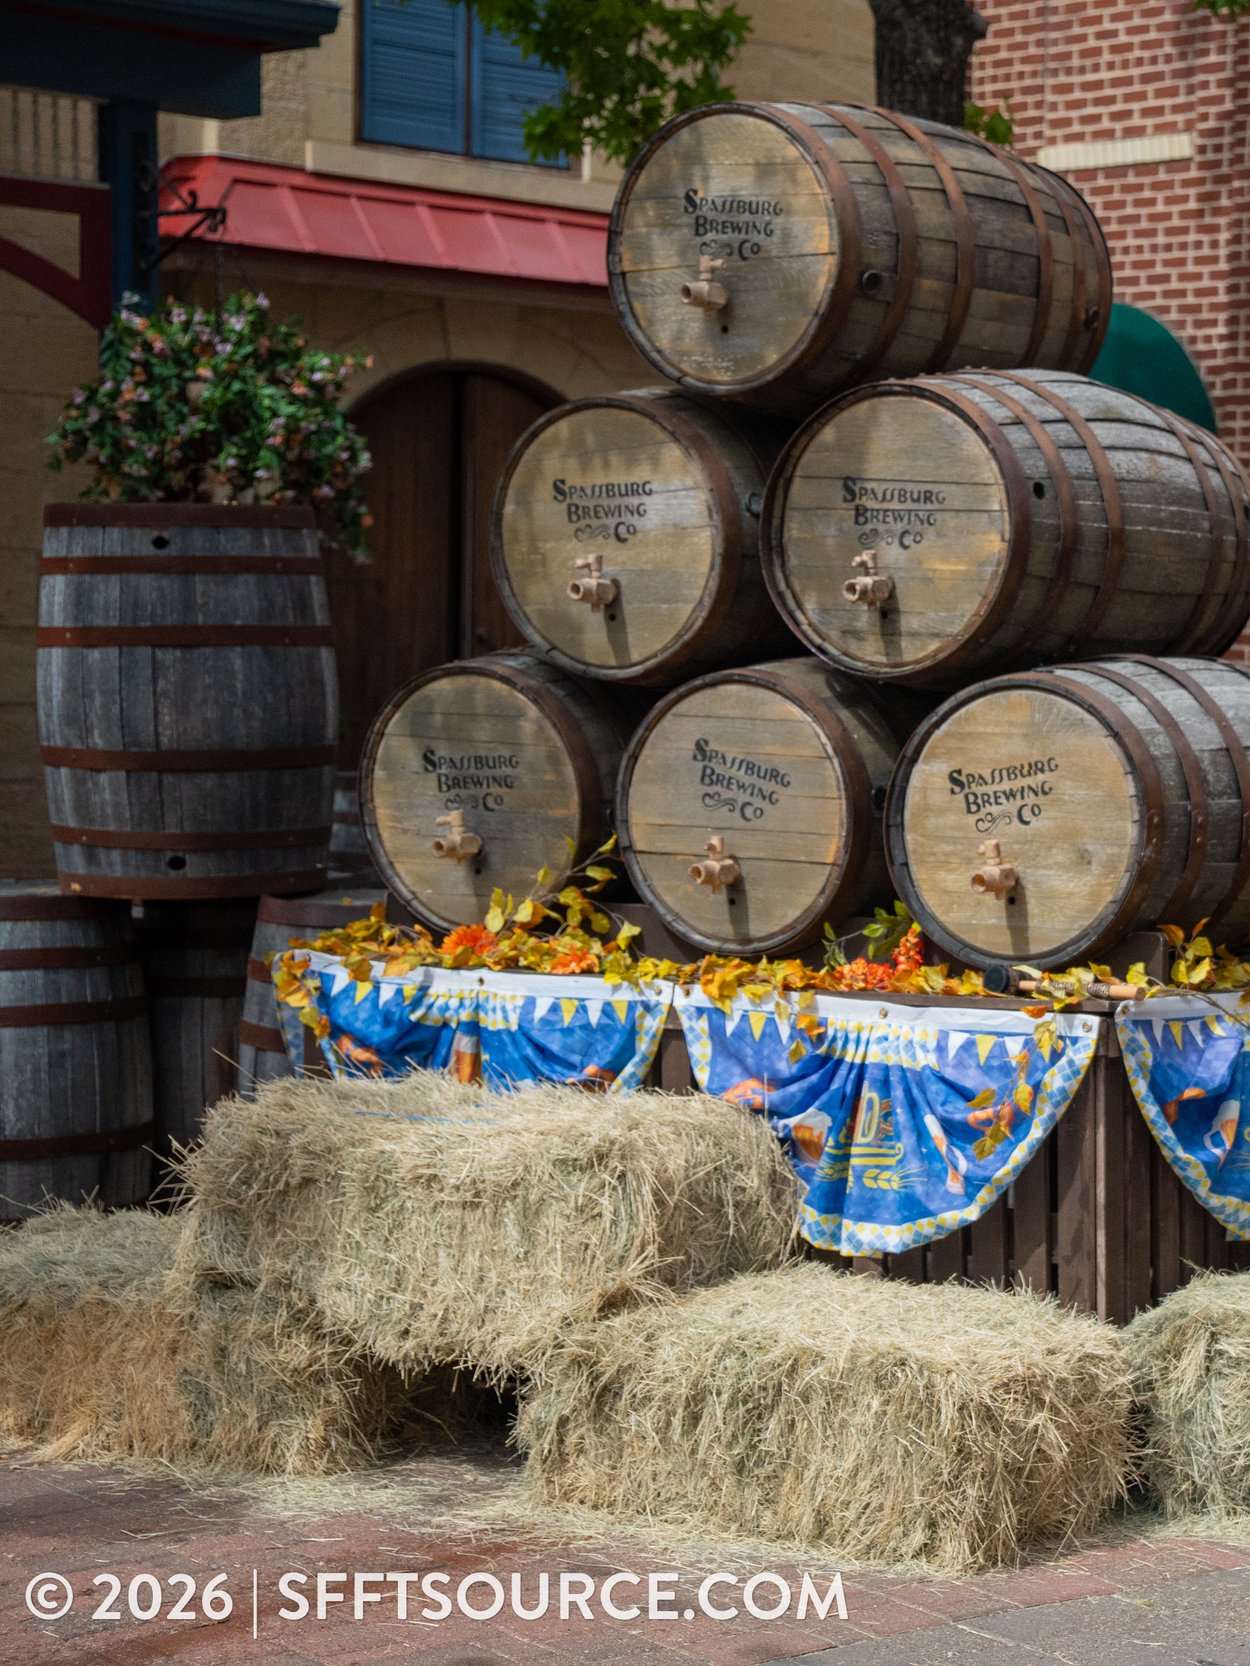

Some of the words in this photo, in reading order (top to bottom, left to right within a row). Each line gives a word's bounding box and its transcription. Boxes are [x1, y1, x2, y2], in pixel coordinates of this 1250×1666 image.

[694, 215, 775, 238] BREWING
[566, 502, 648, 524] BREWING
[854, 503, 938, 527] BREWING
[437, 773, 515, 794] BREWING
[700, 764, 780, 806] BREWING
[963, 780, 1054, 815] BREWING
